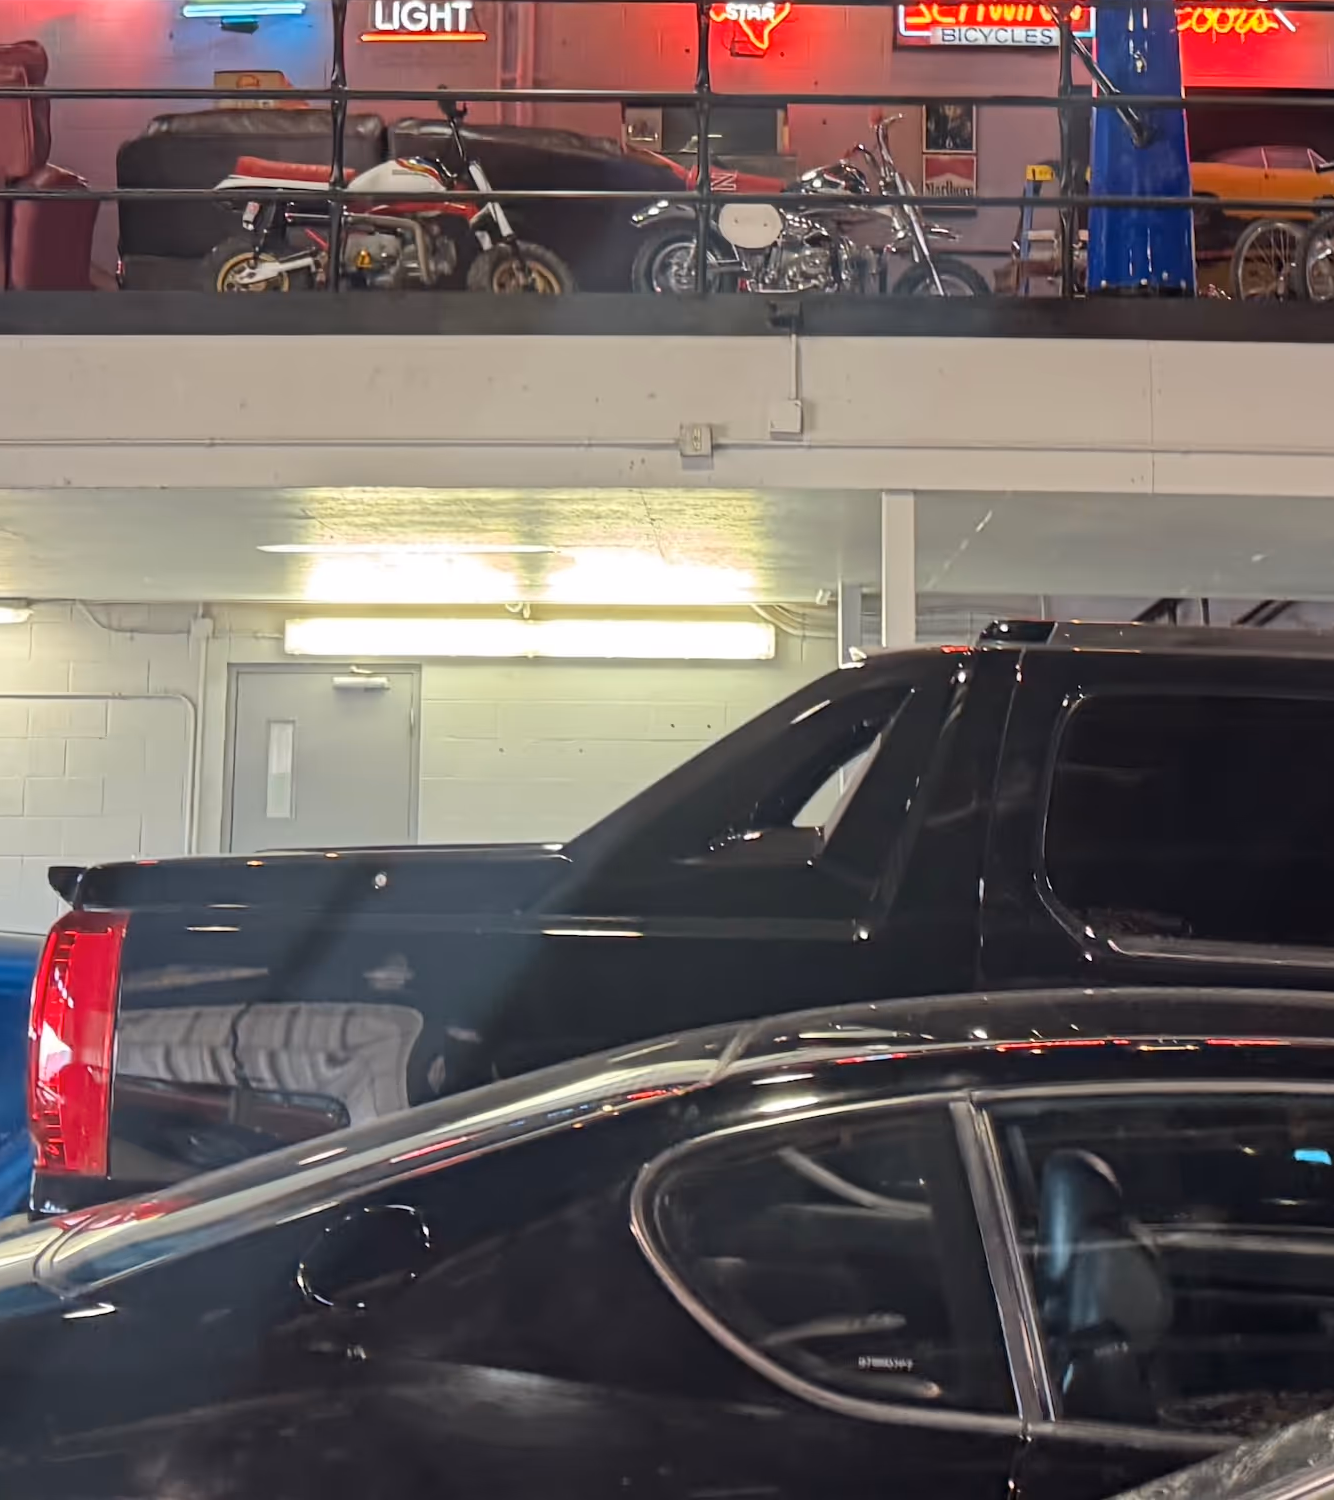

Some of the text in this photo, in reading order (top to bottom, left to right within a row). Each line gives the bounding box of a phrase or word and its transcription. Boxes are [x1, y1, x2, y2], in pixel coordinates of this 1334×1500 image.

[374, 0, 473, 32] LIGHT
[725, 2, 775, 21] STAR
[941, 26, 1054, 45] BICYCLES
